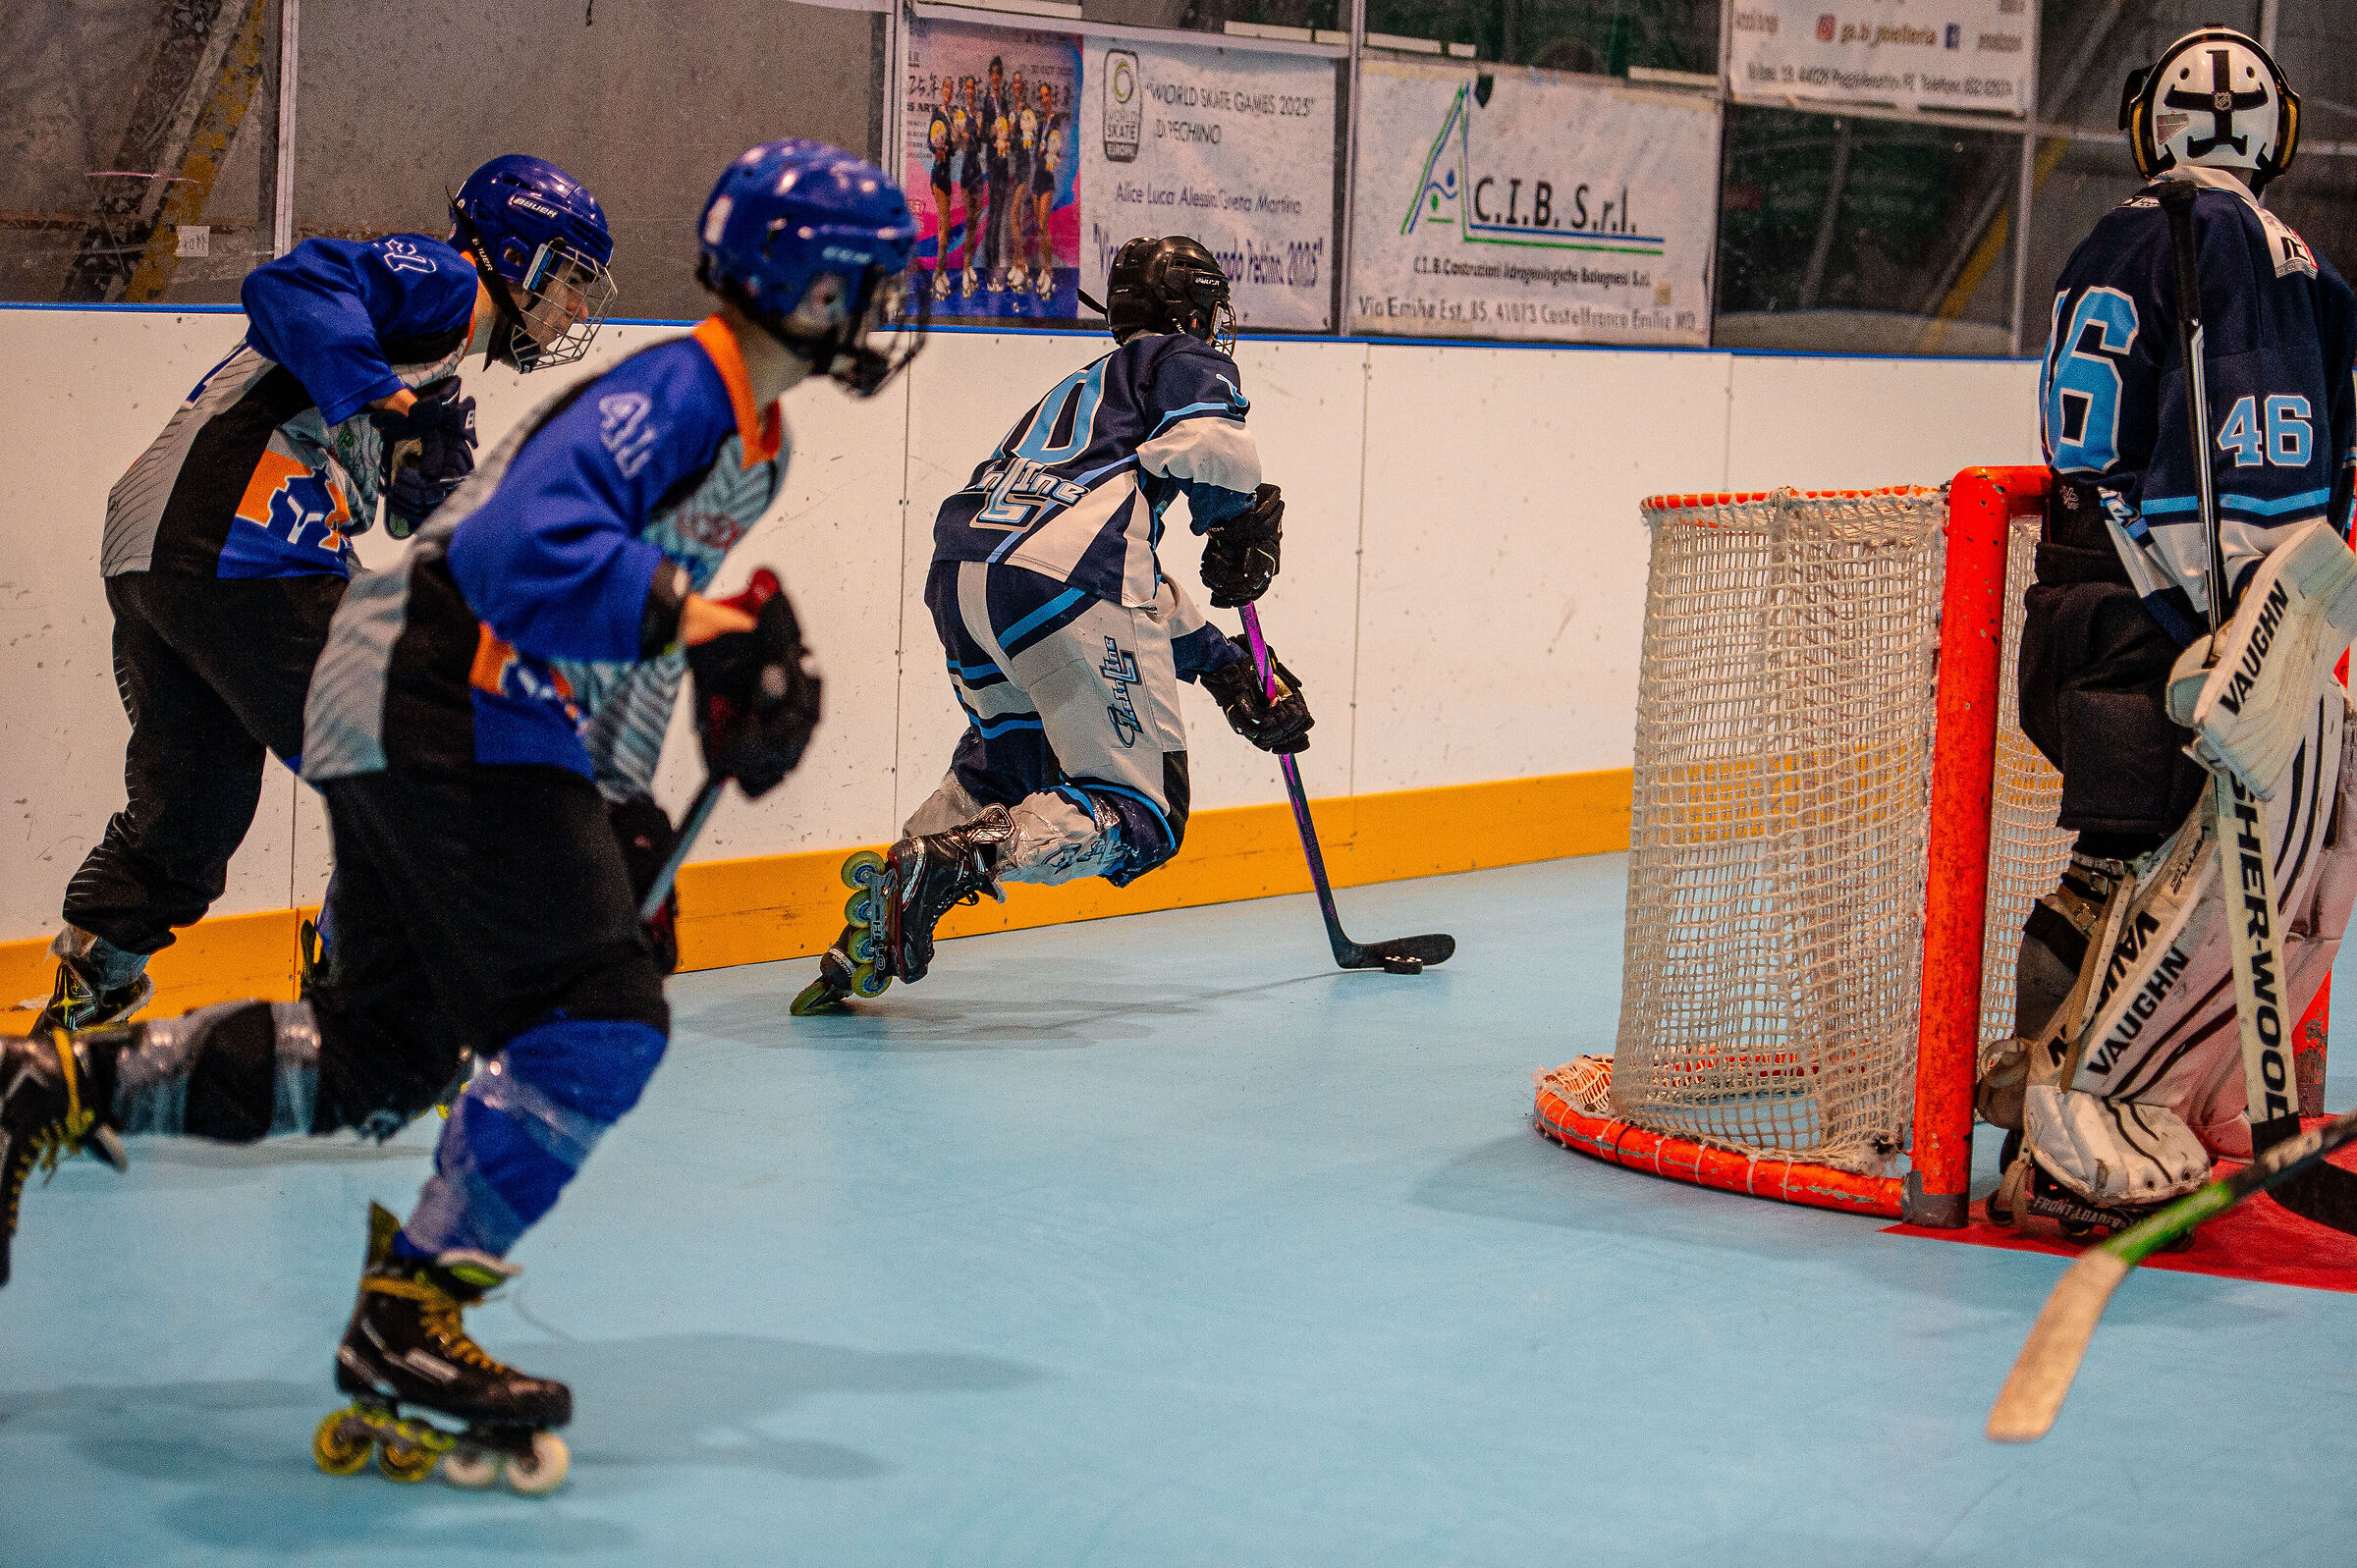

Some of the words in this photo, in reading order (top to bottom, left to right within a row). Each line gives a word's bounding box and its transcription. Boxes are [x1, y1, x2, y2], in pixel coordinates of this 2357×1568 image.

[1200, 87, 1231, 111] SKATE
[1233, 90, 1275, 115] GAMES
[1107, 123, 1136, 140] SKATE
[515, 197, 559, 219] BAUER
[1474, 176, 1560, 229] C.I.B.
[1571, 181, 1638, 234] S.r.l.
[1358, 296, 1385, 317] Via
[2217, 394, 2314, 467] 46
[2218, 577, 2290, 716] VAUGHN
[2086, 946, 2192, 1077] VAUGHN
